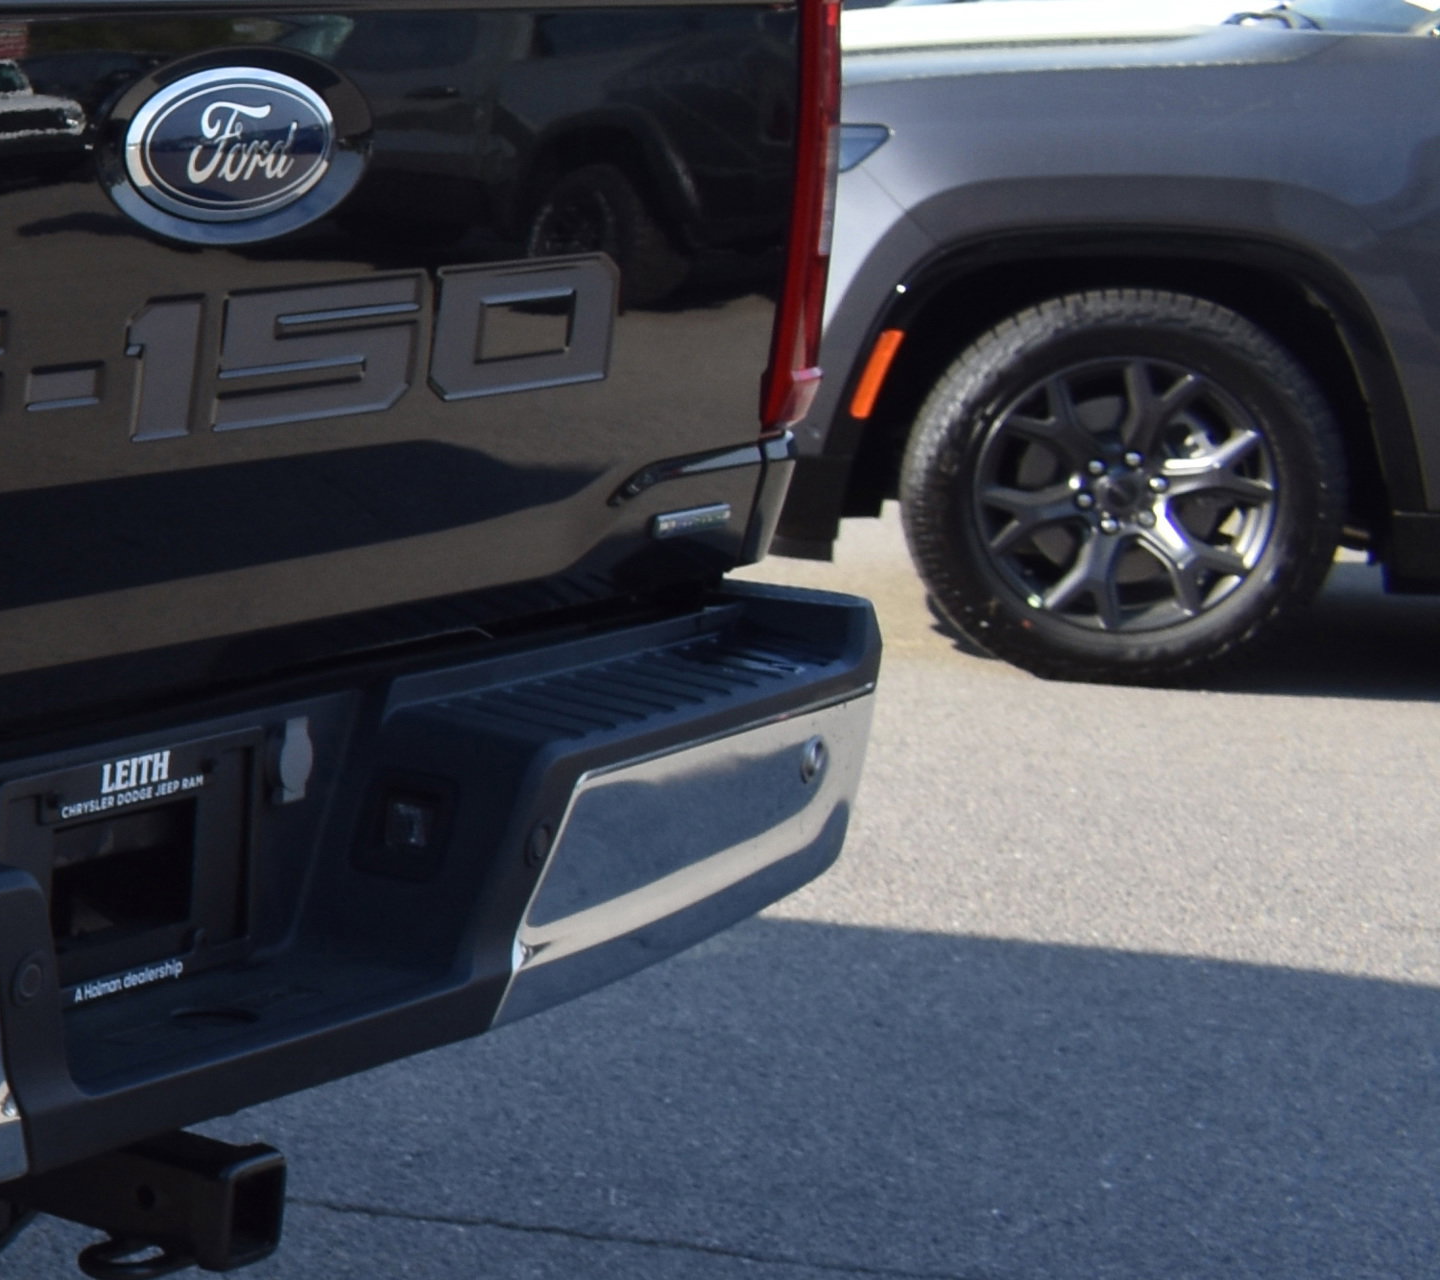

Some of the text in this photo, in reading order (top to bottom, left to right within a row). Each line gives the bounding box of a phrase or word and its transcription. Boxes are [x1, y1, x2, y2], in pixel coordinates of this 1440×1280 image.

[187, 101, 298, 185] Ford
[100, 749, 171, 794] LEITH
[61, 774, 205, 819] CHRYSLER DODGE JEEP RAM
[74, 959, 184, 1003] A Holman dealership
